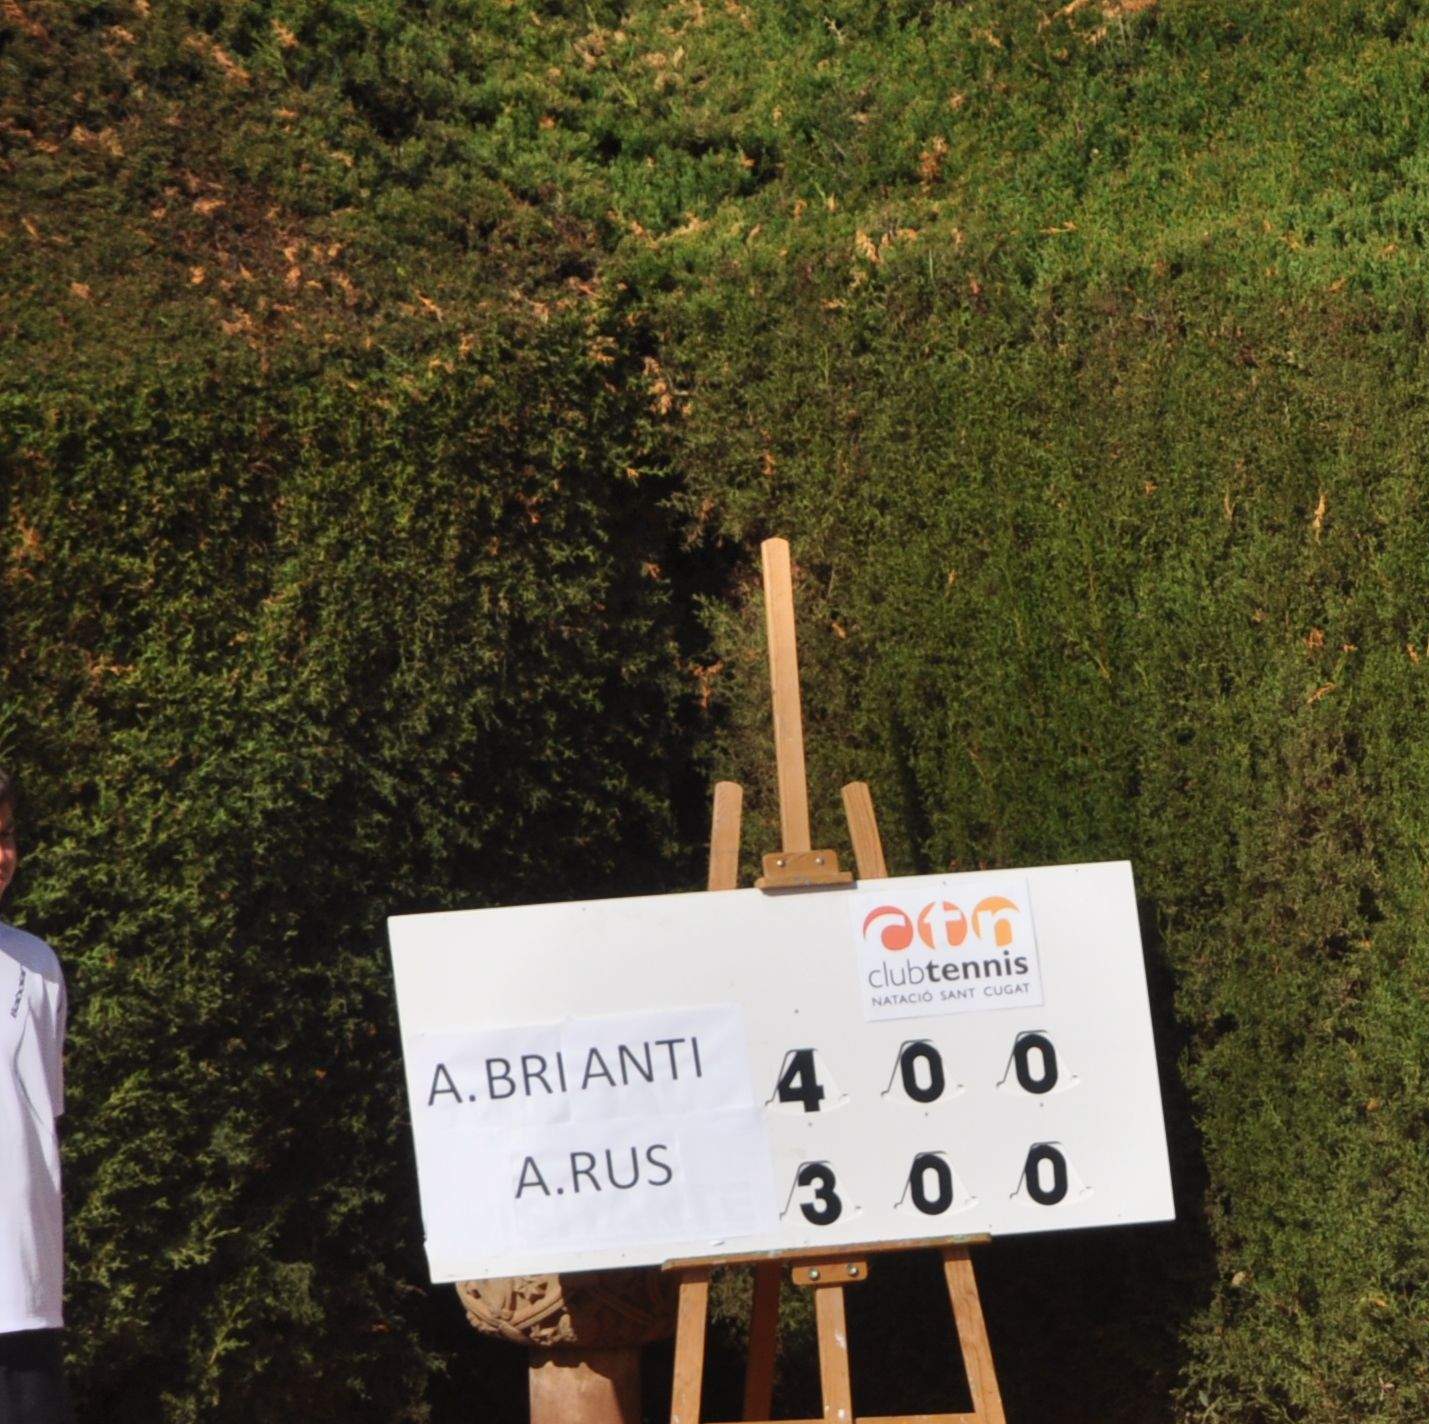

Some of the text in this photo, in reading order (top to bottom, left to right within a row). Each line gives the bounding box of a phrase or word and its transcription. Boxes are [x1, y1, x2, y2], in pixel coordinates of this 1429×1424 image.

[868, 950, 1029, 989] clubtennis
[872, 982, 1030, 1007] NATACIÓ SANT CUGAT
[778, 1050, 825, 1113] 4
[901, 1042, 945, 1103] 0
[1014, 1034, 1058, 1094] 0
[515, 1144, 1068, 1226] A.RUS 3 0 0
